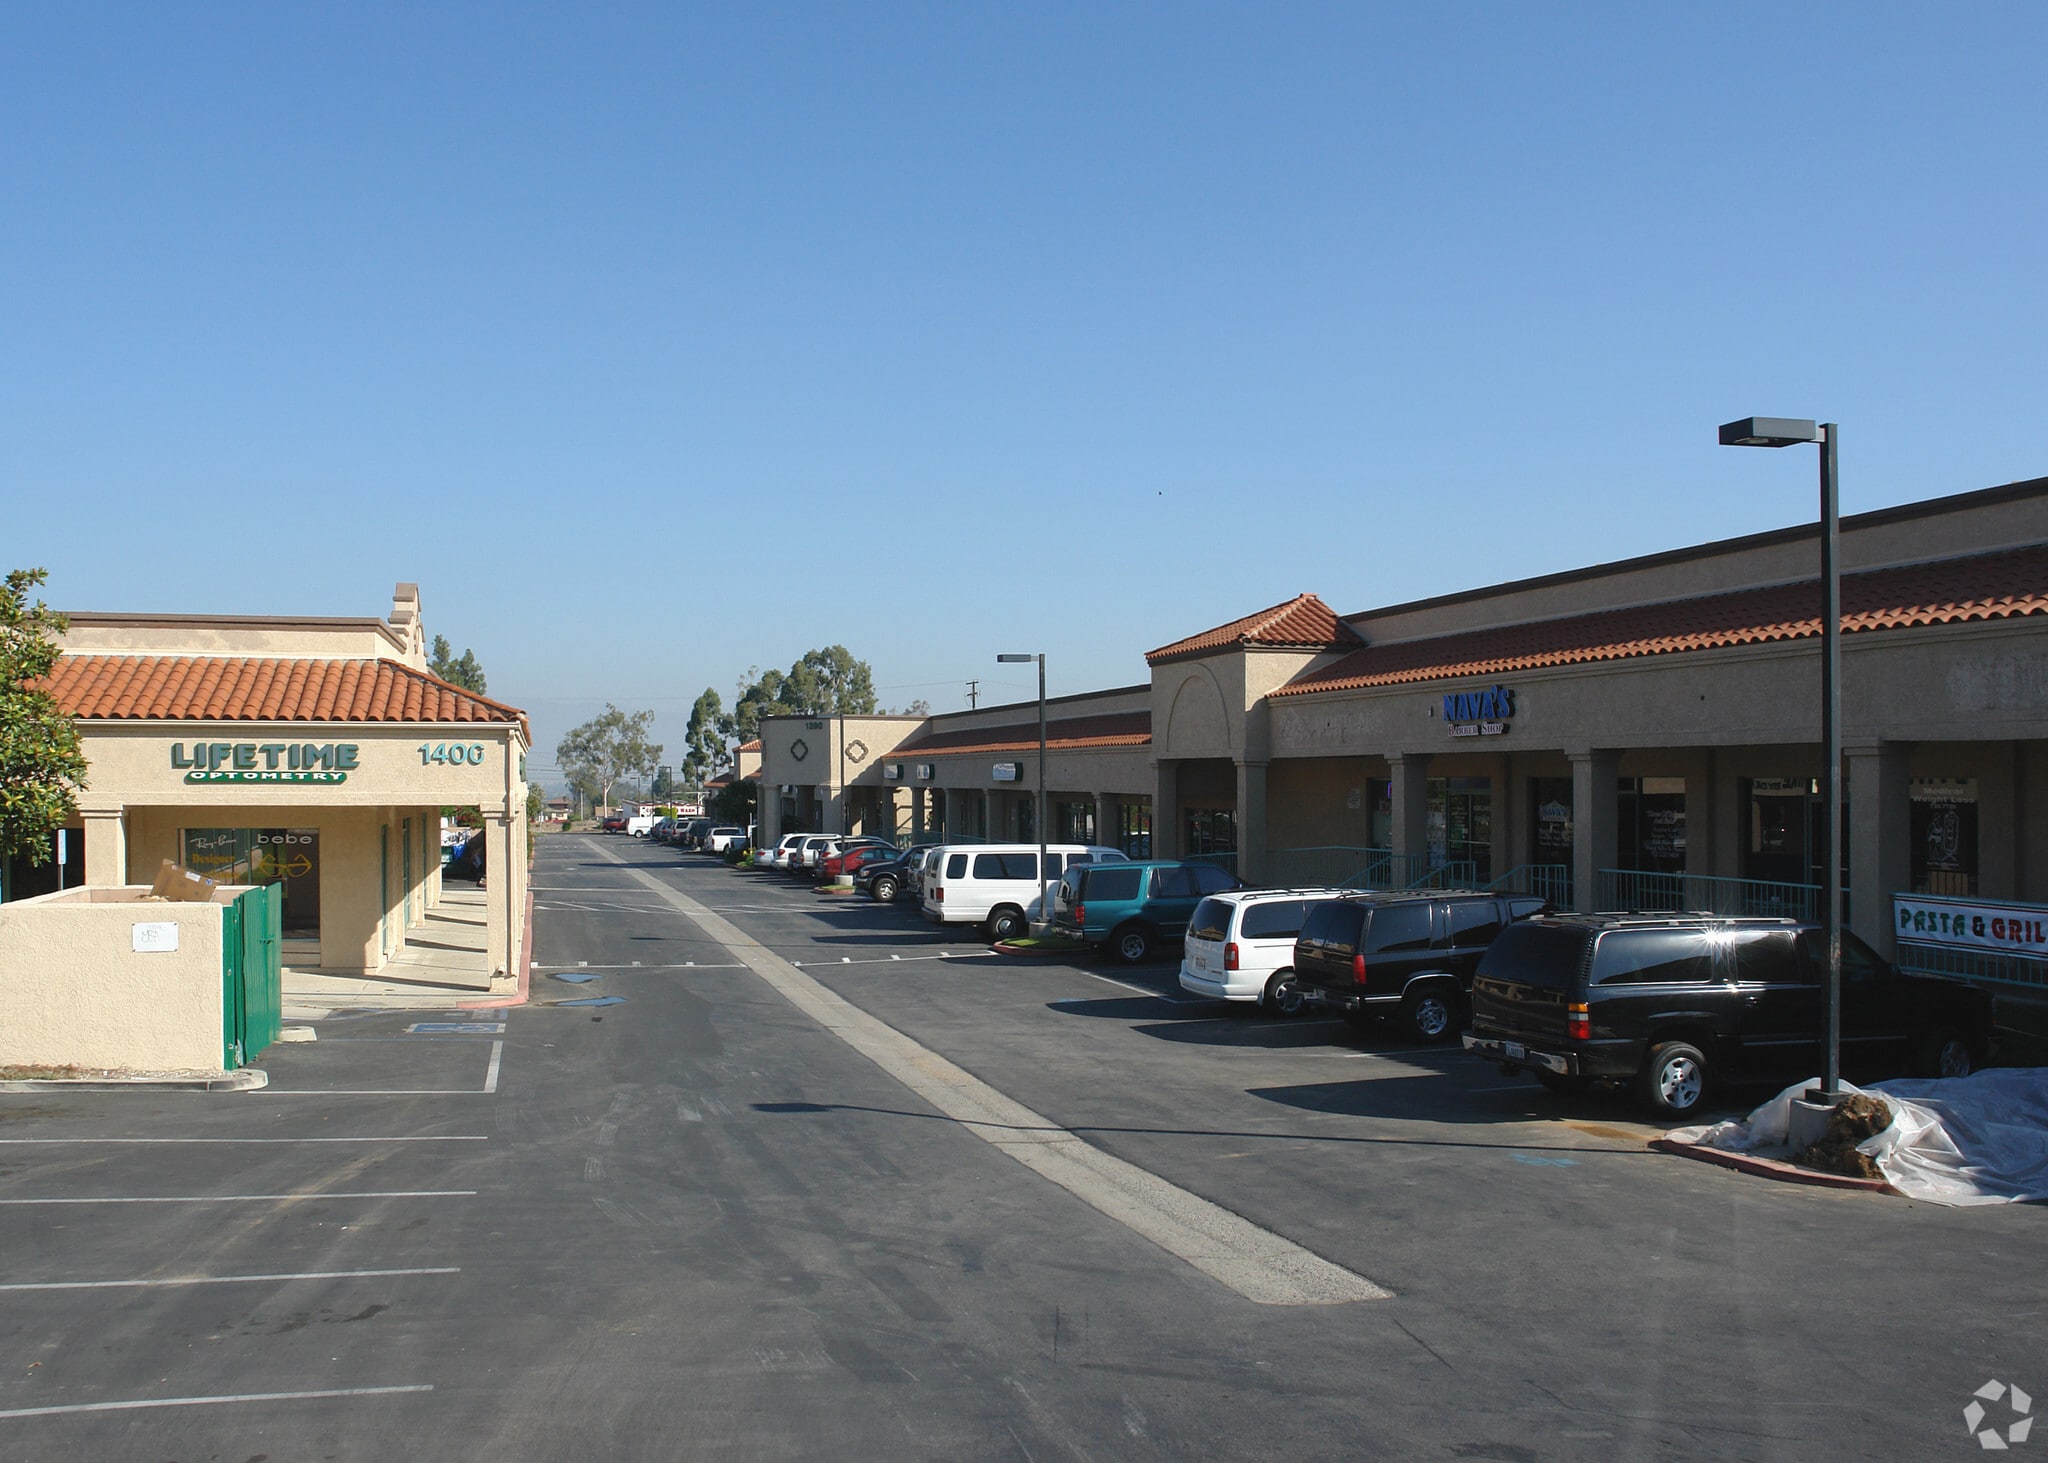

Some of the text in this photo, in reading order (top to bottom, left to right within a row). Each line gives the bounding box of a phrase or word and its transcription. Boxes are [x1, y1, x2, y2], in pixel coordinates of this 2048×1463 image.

[1443, 685, 1511, 721] NAVA'S
[1448, 722, 1505, 737] BARBER SHOP
[171, 743, 360, 771] LIFETIME
[419, 743, 485, 765] 1400
[190, 771, 344, 781] OPTOMETRY
[257, 833, 312, 844] bebe
[1900, 908, 1966, 938] PASTA
[1972, 915, 1986, 938] &
